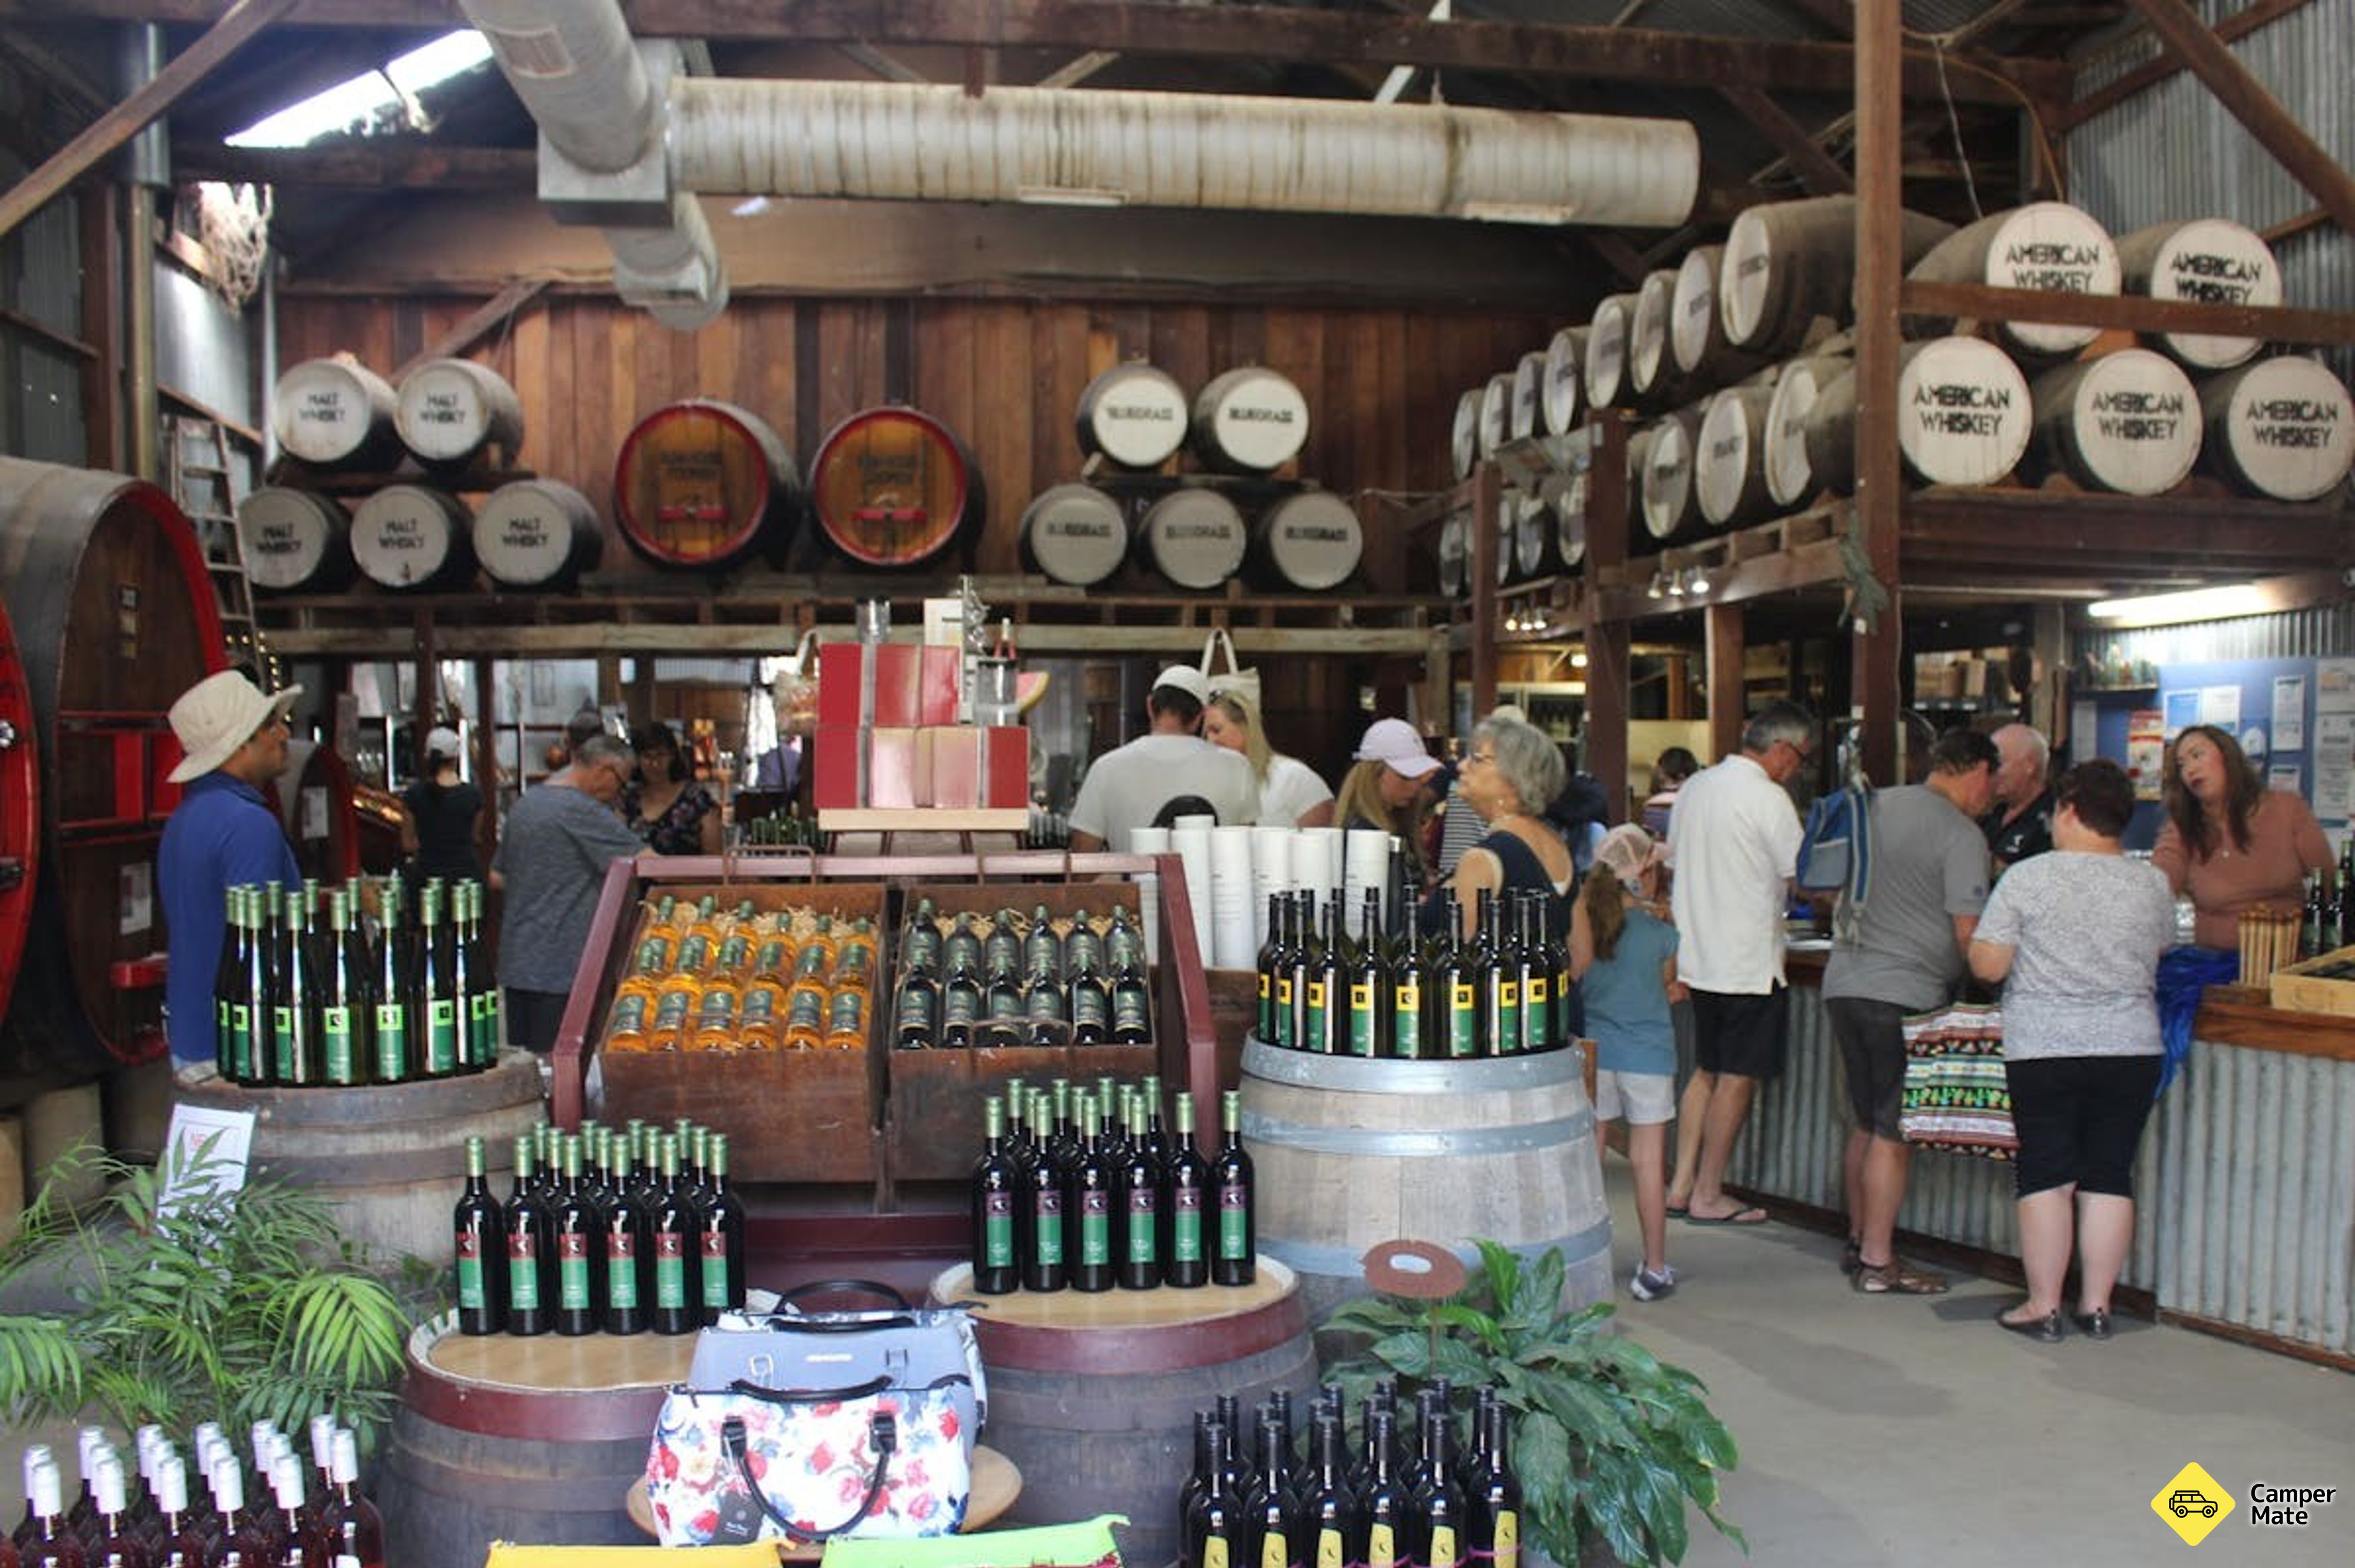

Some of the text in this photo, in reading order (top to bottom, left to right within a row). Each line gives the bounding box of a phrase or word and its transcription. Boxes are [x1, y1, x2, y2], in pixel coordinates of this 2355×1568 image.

[2005, 242, 2100, 265] AMERICAN
[2170, 252, 2262, 283] AMERICAN
[2013, 269, 2093, 293] WHISKEY
[2175, 277, 2253, 307] WHISKEY
[1913, 384, 2011, 409] AMERICAN
[2091, 391, 2184, 414] AMERICAN
[2246, 399, 2339, 422] AMERICAN
[1920, 411, 2003, 436] WHISKEY
[2098, 416, 2178, 440] WHISKEY
[2253, 425, 2333, 449] WHISKEY
